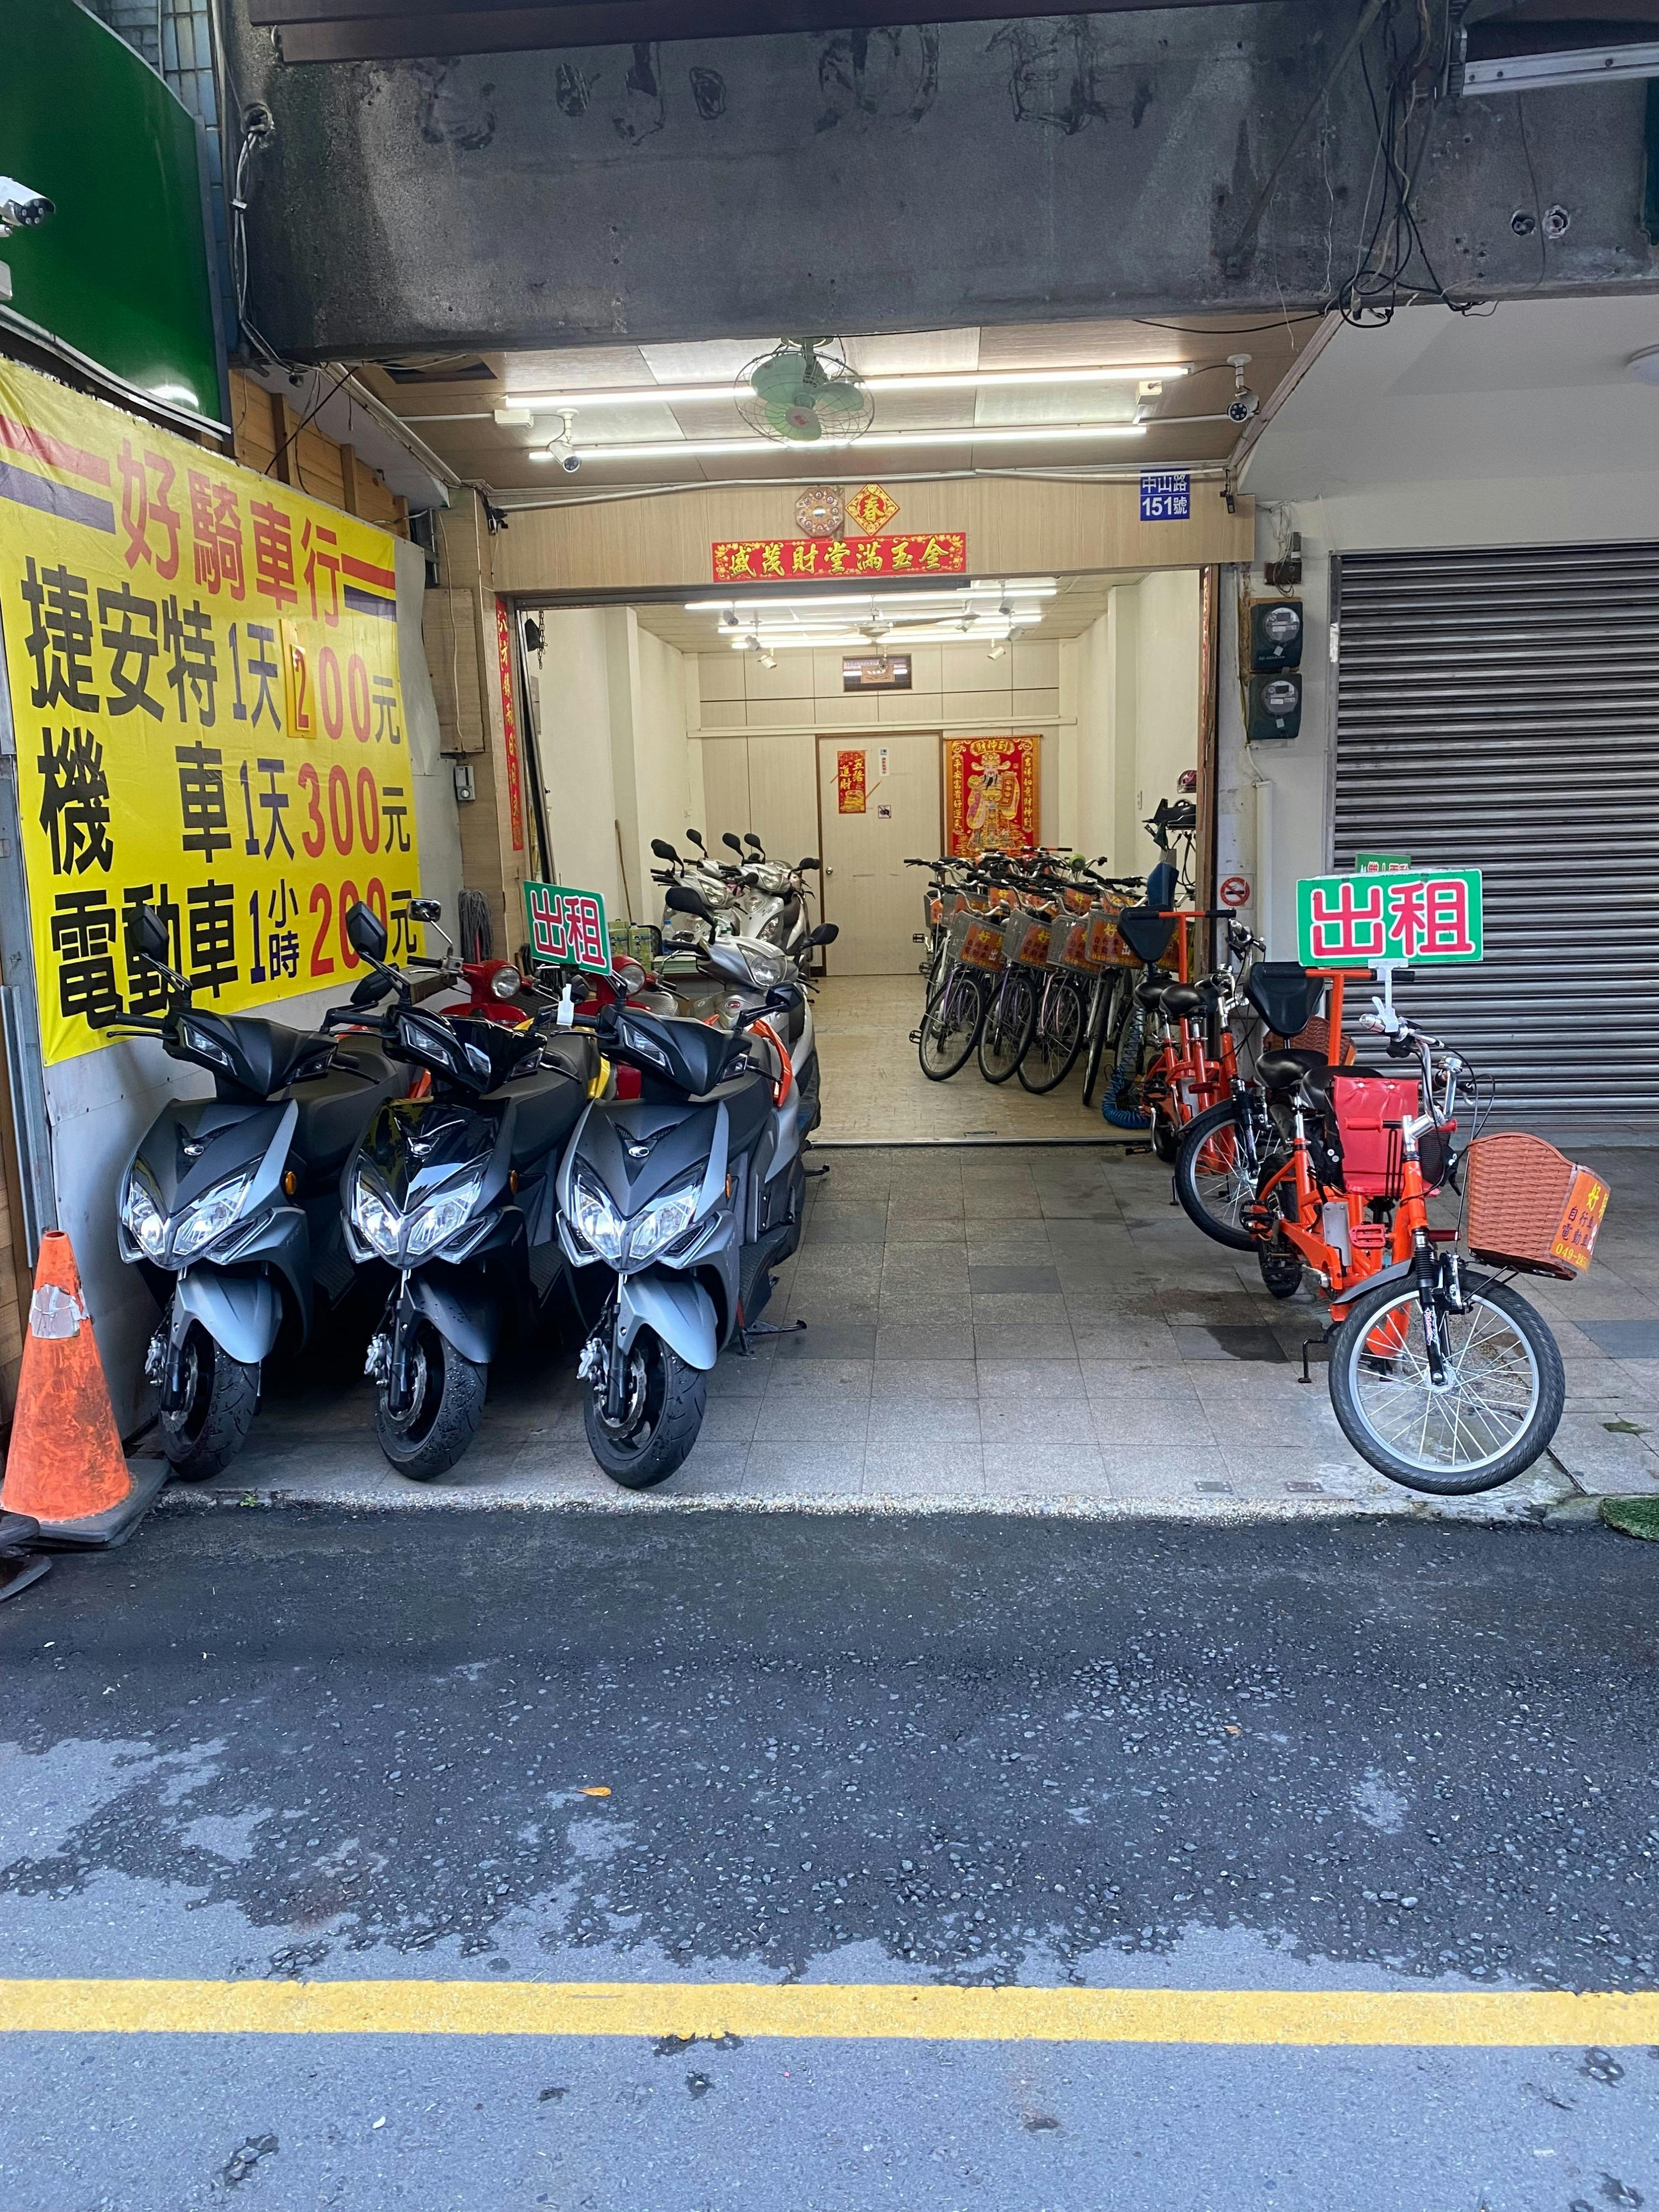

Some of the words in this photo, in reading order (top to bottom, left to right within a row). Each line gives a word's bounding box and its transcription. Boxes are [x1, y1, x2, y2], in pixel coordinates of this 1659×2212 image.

[861, 496, 886, 523] 春
[1142, 475, 1187, 493] 中山路
[1142, 496, 1187, 517] 151號
[117, 439, 343, 628] 好騎車行
[530, 888, 606, 967] 出租
[1311, 879, 1475, 958] 出租
